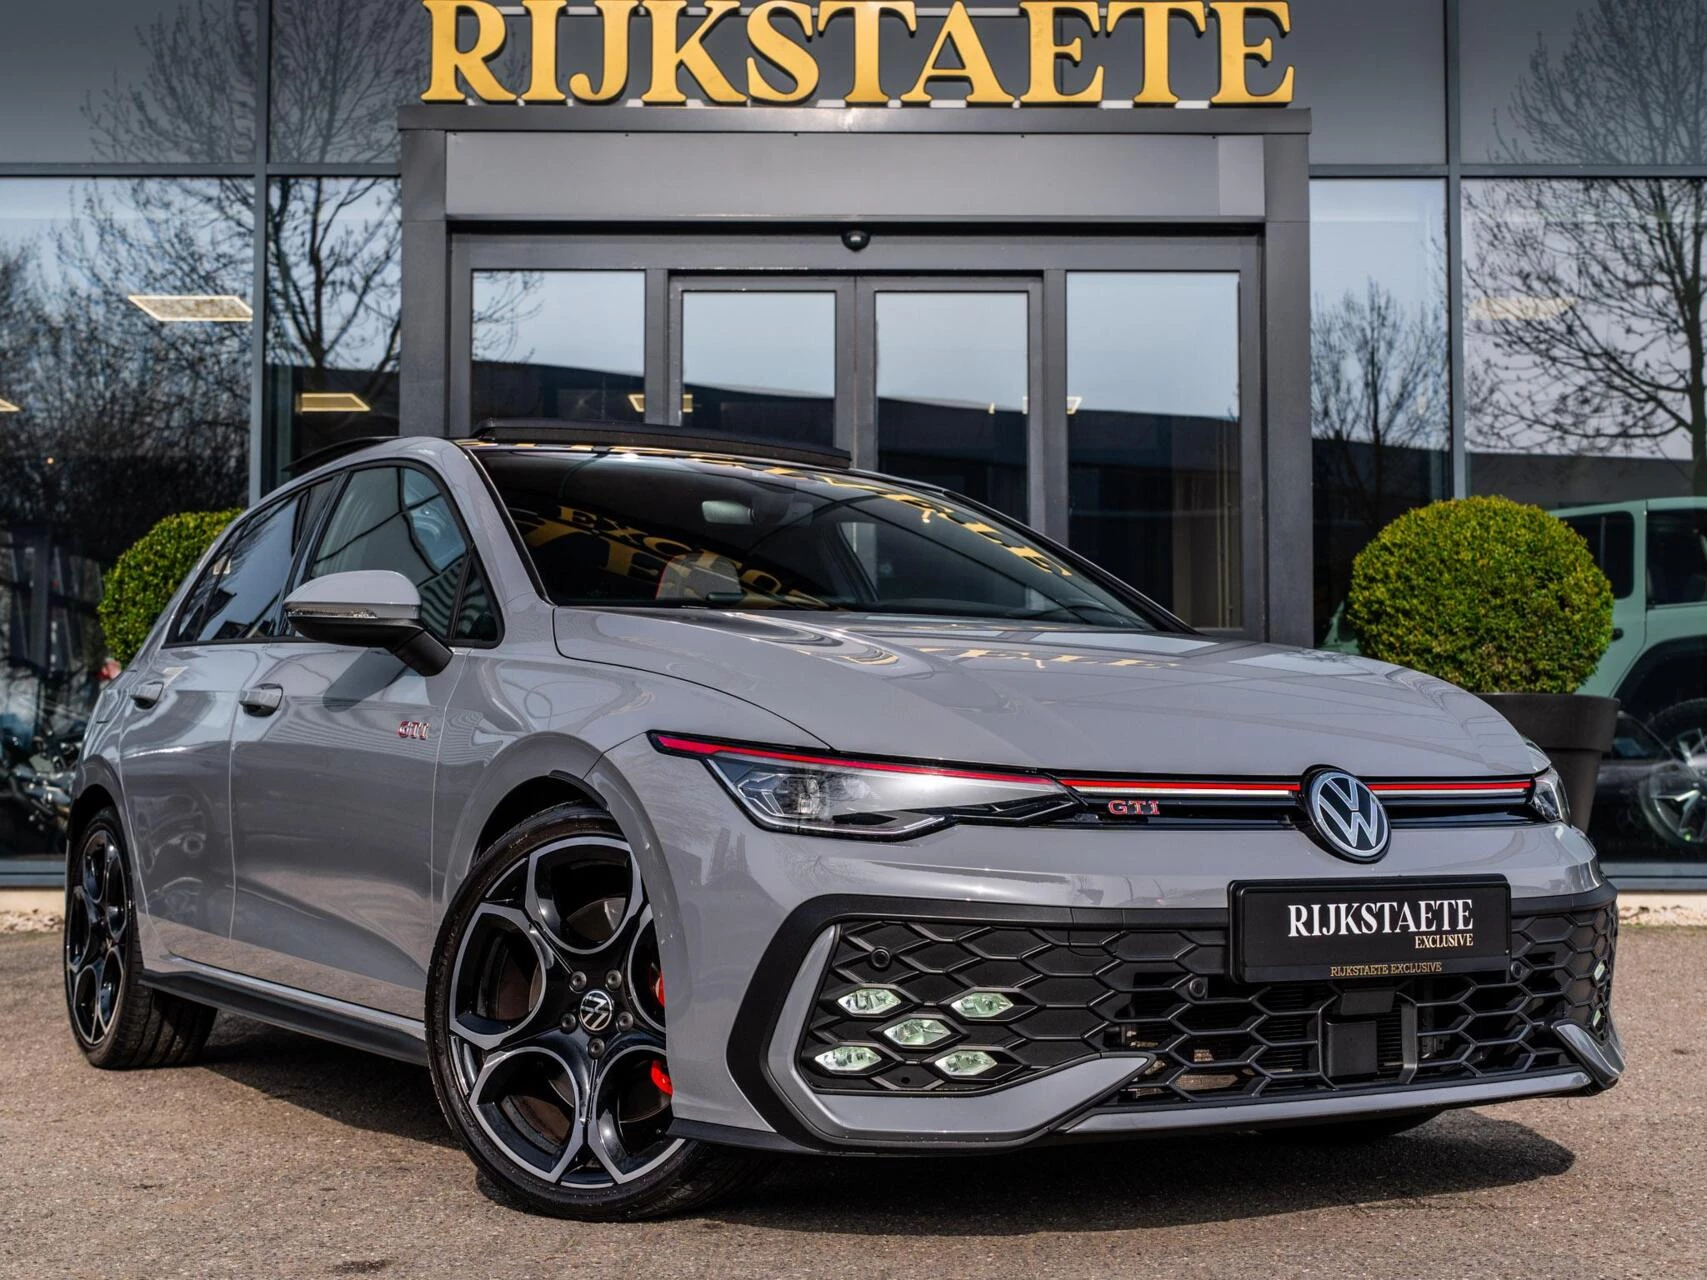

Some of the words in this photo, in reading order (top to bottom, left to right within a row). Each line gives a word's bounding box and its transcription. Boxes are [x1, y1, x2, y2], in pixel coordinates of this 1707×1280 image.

[421, 0, 1295, 105] RIJKSTAETE
[1107, 799, 1161, 816] GTI
[1287, 898, 1474, 938] RIJKSTAETE
[1414, 933, 1474, 950] EXCLUSIVE
[1329, 964, 1389, 977] RIJKSTAETE
[1390, 961, 1443, 974] EXCLUSIVE
